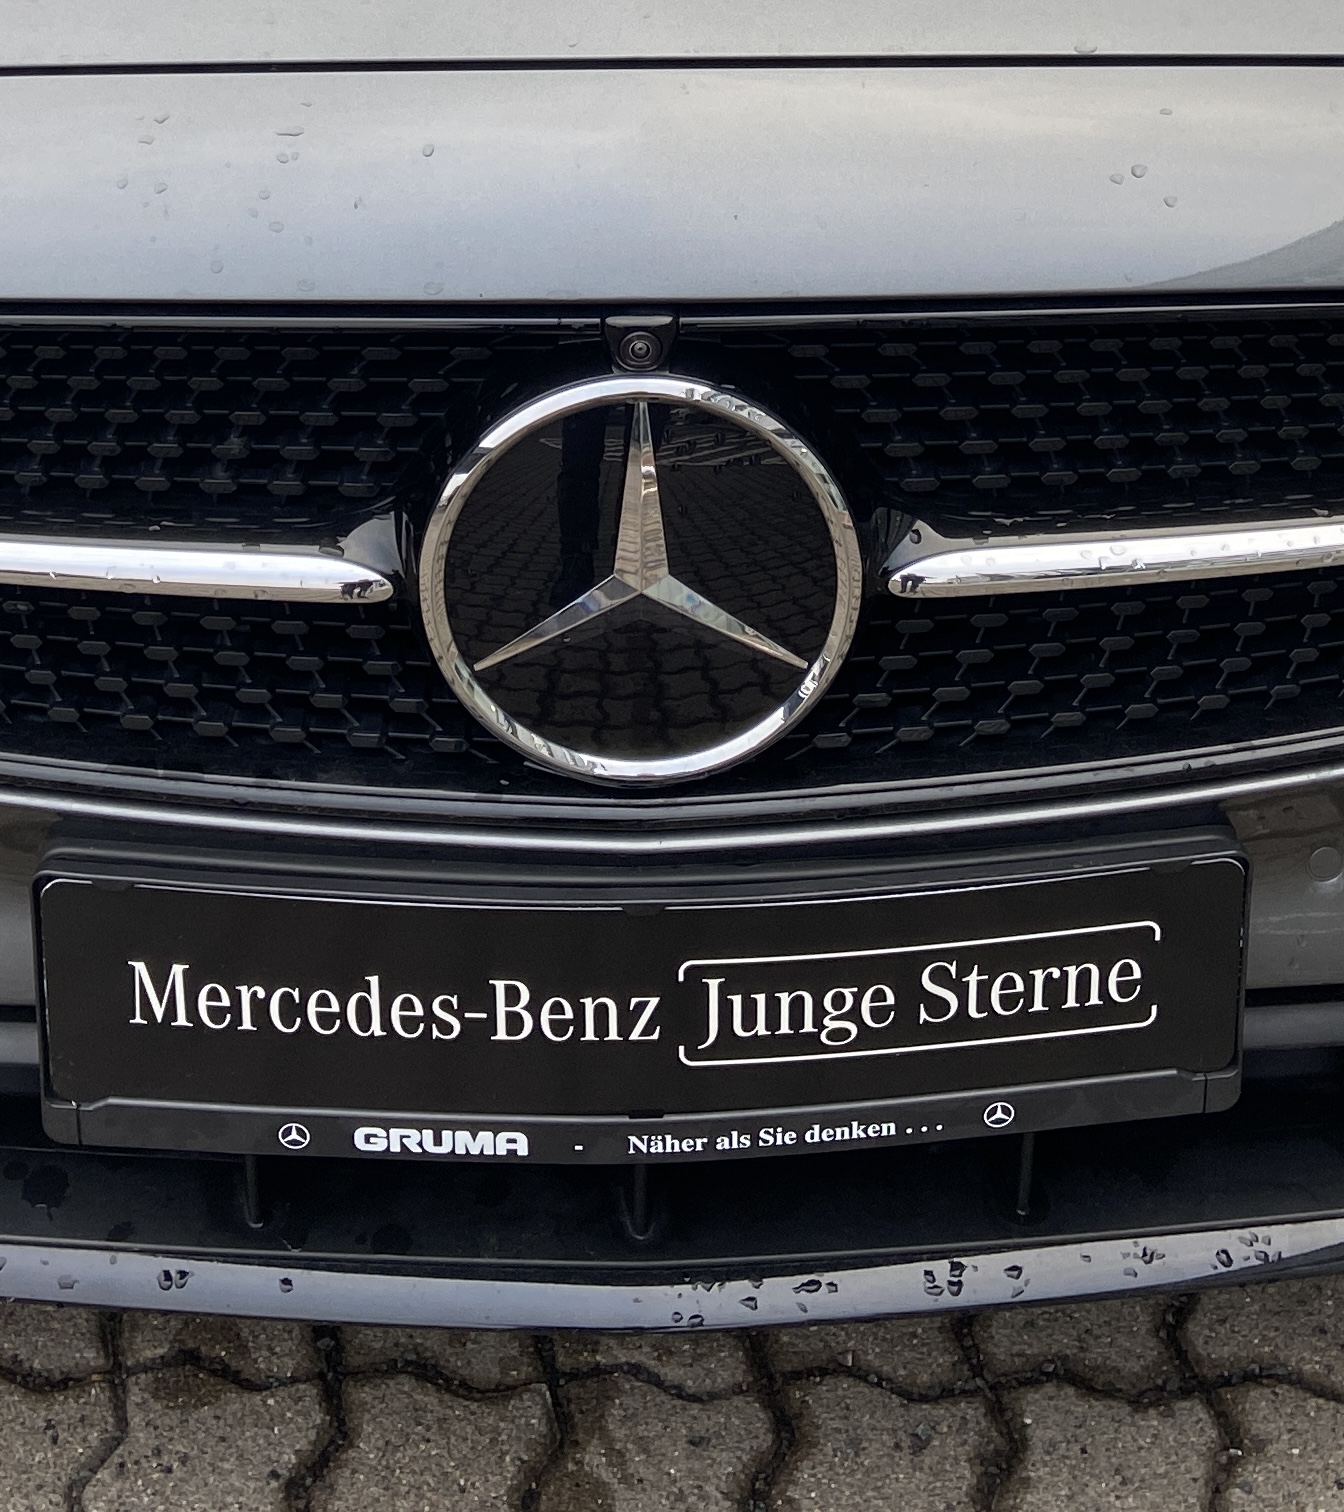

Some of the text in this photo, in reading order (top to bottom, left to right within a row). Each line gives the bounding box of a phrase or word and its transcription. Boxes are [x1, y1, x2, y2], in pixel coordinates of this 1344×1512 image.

[128, 956, 1142, 1050] Mercedes-Benz Junge Sterne
[353, 1126, 529, 1156] GRUMA
[627, 1133, 709, 1155] Näher
[715, 1130, 751, 1151] als
[758, 1127, 798, 1147] Sie
[805, 1120, 897, 1145] denken
